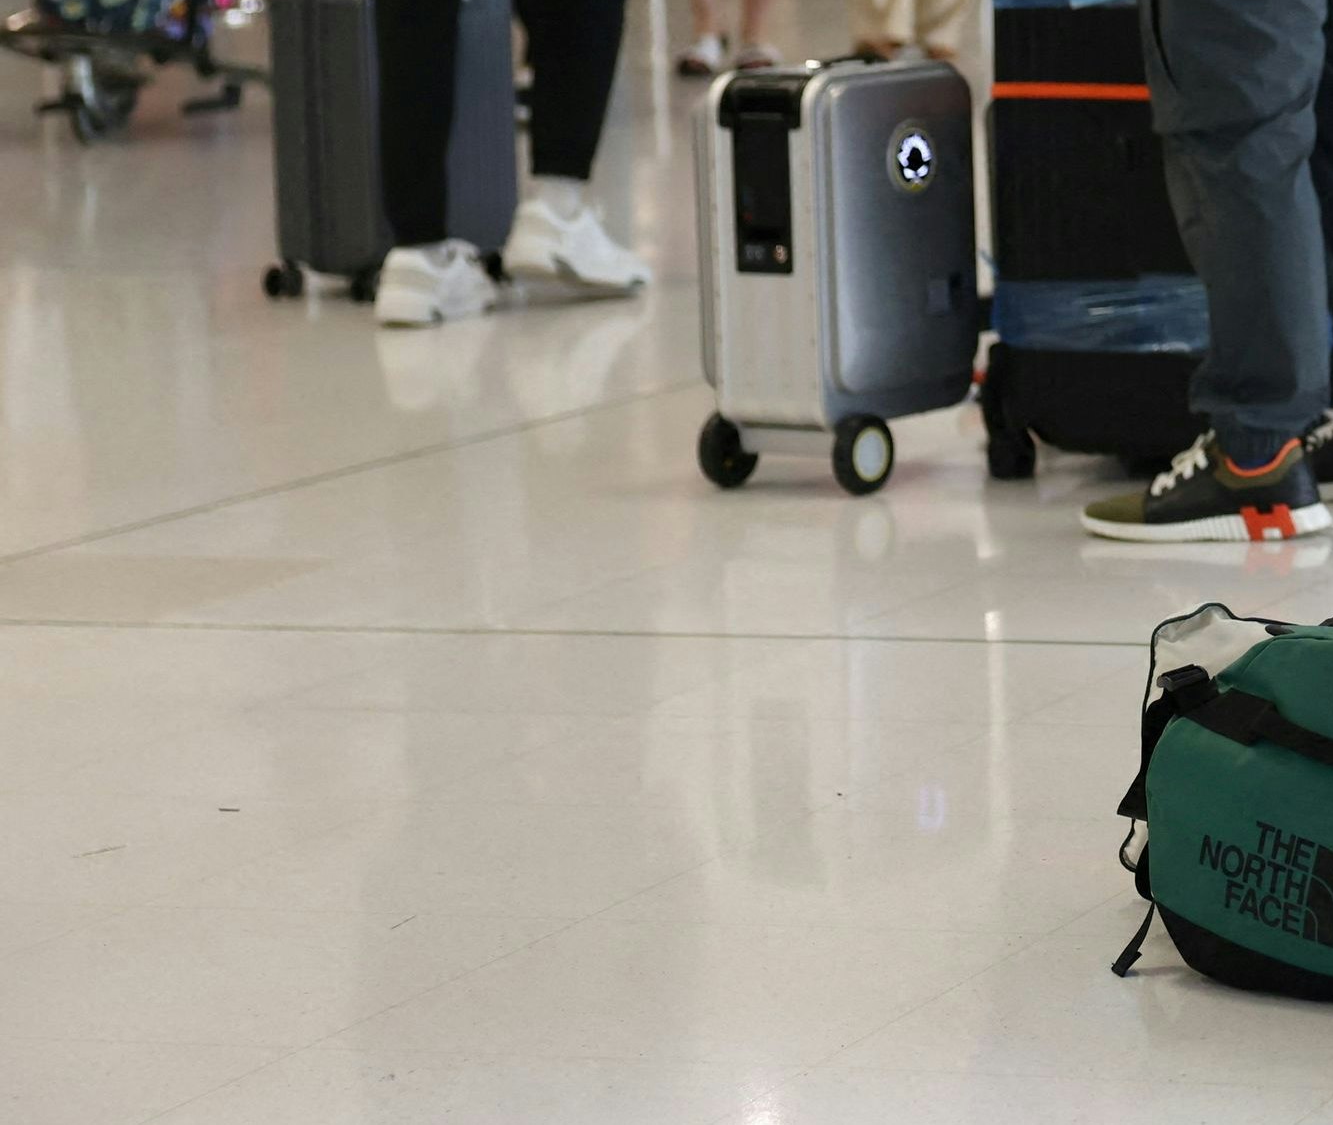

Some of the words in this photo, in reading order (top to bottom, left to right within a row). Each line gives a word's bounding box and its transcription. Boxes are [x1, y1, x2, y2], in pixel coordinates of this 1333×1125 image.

[1199, 835, 1309, 905] NORTH
[1256, 820, 1316, 873] THE
[1224, 878, 1302, 936] FACE
